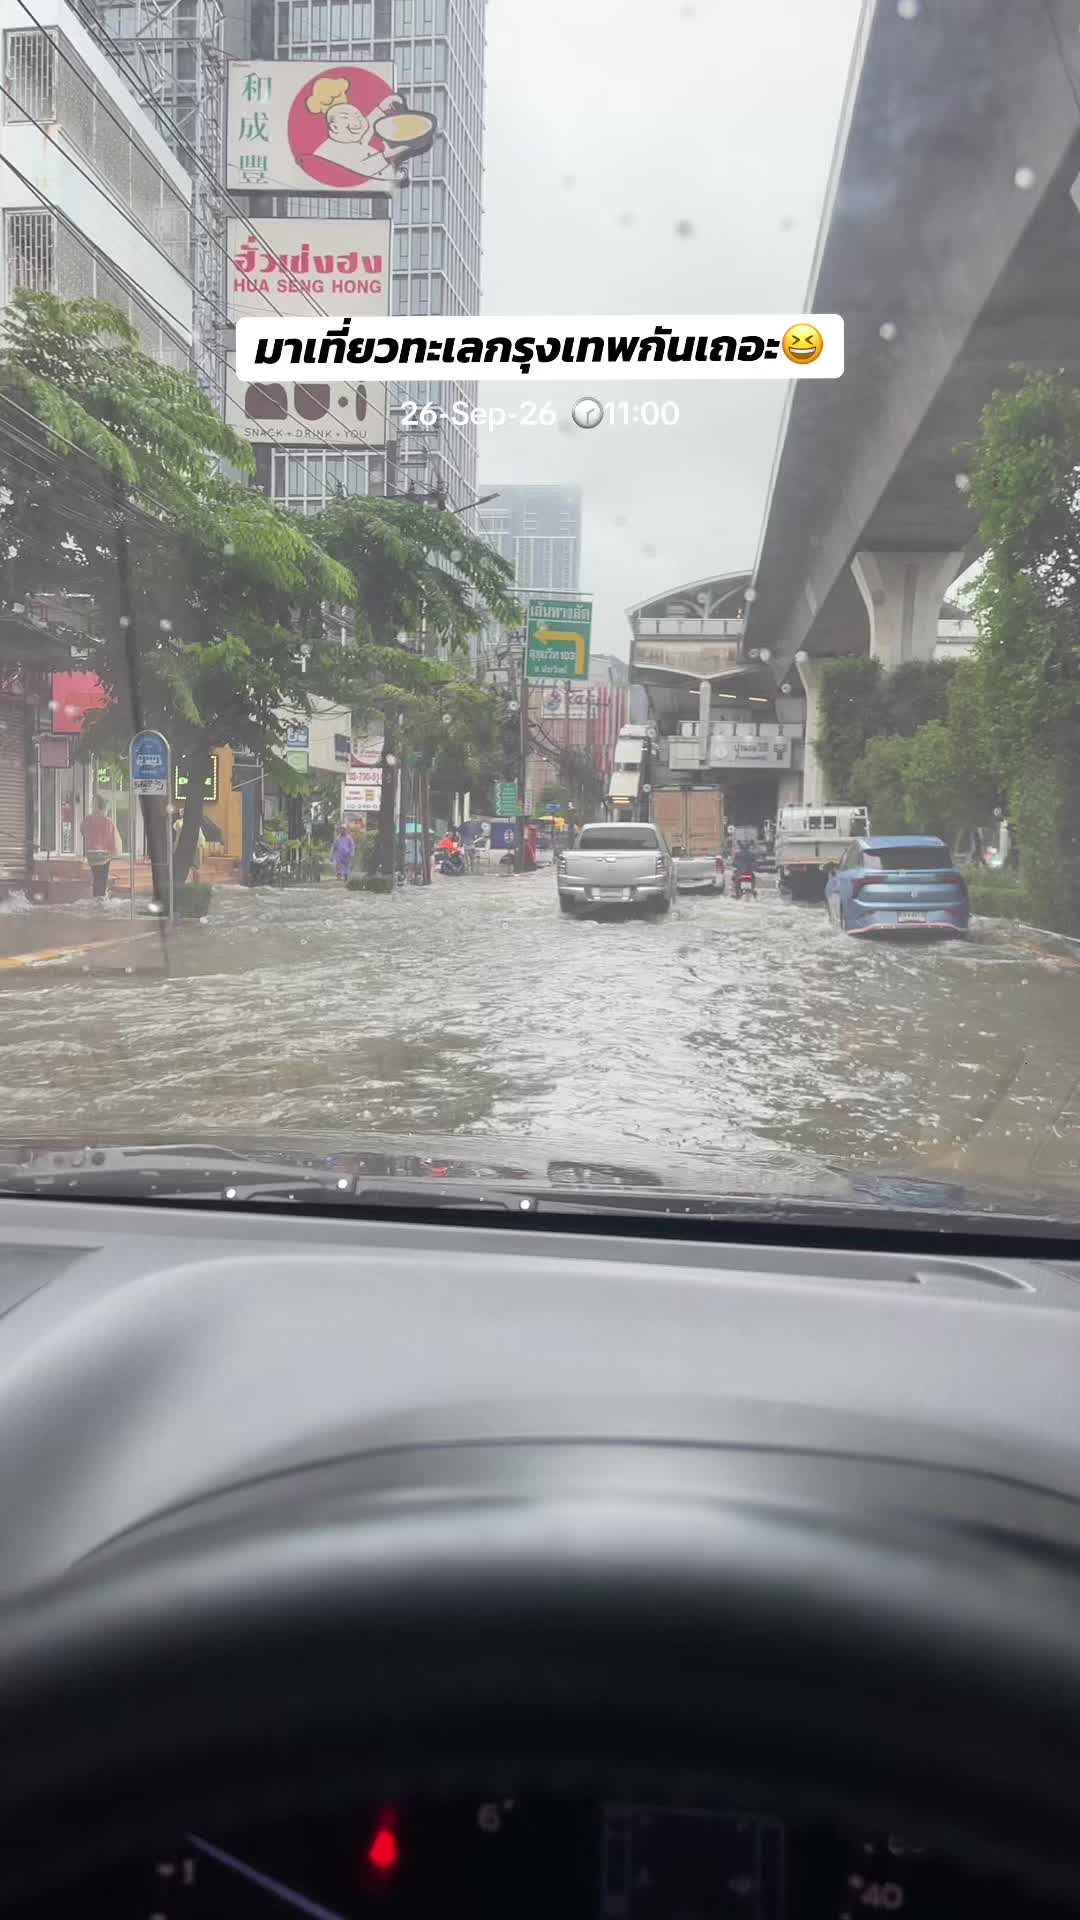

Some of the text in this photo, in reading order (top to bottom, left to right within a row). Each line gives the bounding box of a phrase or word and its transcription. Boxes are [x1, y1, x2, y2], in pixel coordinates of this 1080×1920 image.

[233, 278, 383, 295] HUA SENG HONG
[244, 427, 367, 440] SNACK DRINK YOU
[477, 1802, 501, 1833] 6
[860, 1881, 904, 1911] 40
